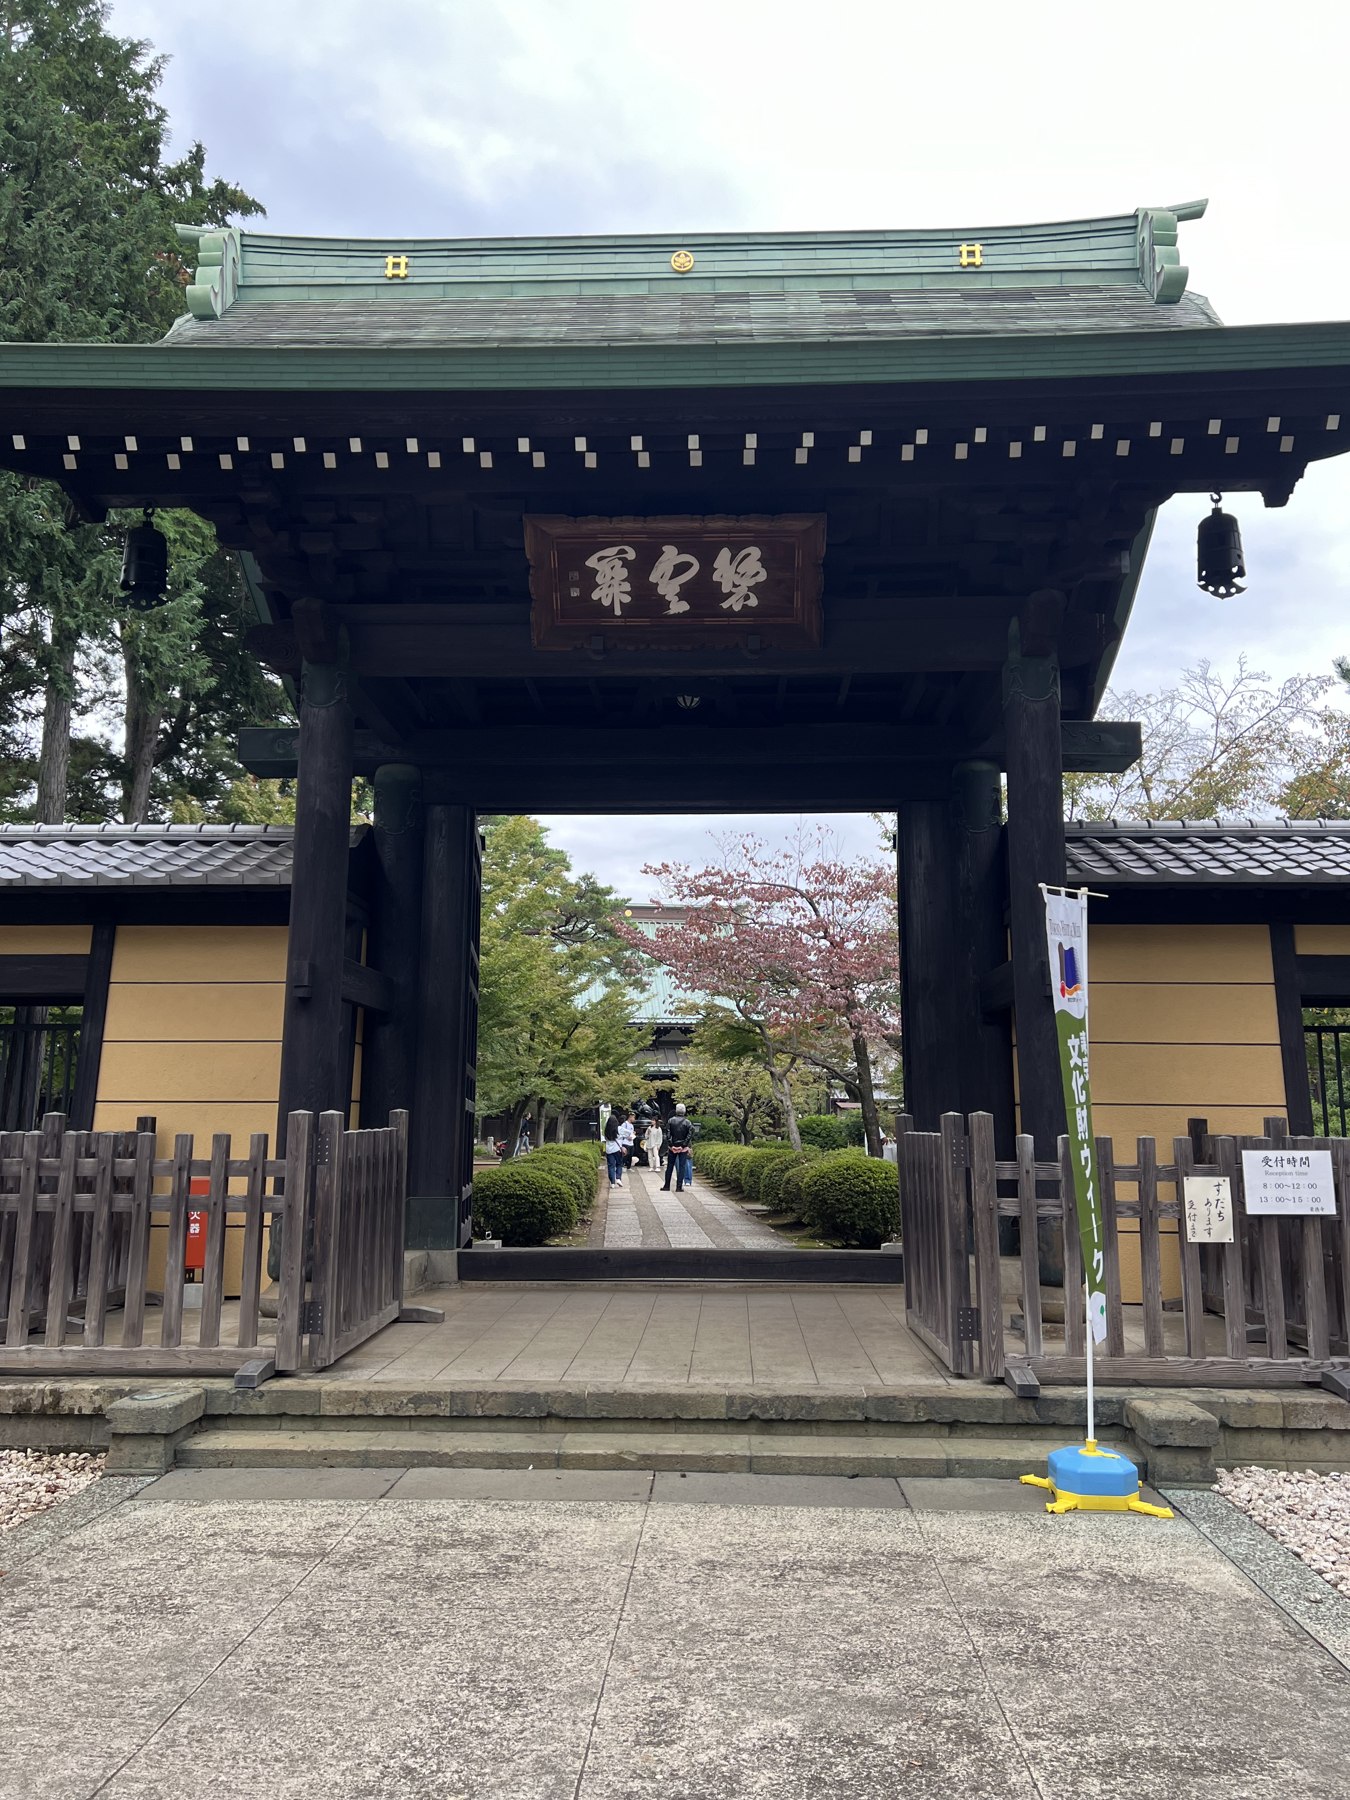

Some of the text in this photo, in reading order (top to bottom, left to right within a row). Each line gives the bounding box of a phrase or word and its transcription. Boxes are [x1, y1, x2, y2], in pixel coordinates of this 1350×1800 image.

[1261, 1155, 1310, 1168] 受付時間
[1213, 1181, 1226, 1222] すだち
[190, 1211, 200, 1233] 火器
[1203, 1198, 1213, 1238] あります
